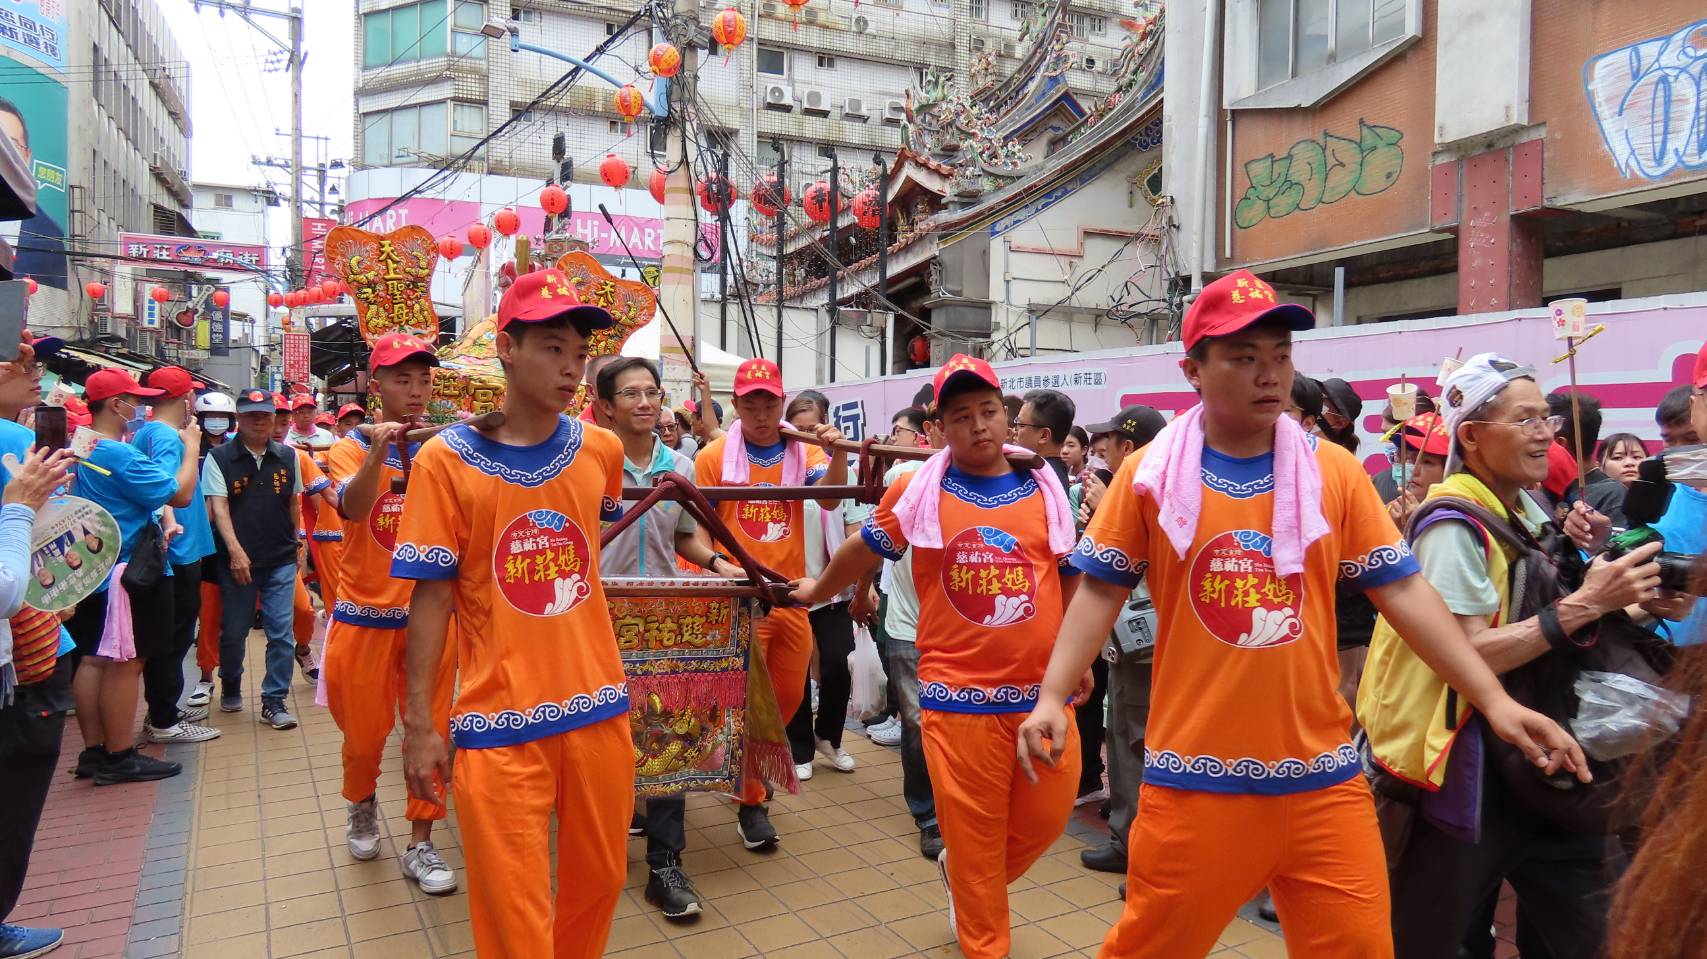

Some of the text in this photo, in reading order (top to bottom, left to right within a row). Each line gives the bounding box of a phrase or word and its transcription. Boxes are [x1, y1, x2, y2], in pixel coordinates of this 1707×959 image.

[379, 240, 409, 325] 天上聖母
[504, 544, 583, 585] 新莊媽
[949, 563, 1031, 596] 新莊媽
[1199, 572, 1296, 608] 新莊媽
